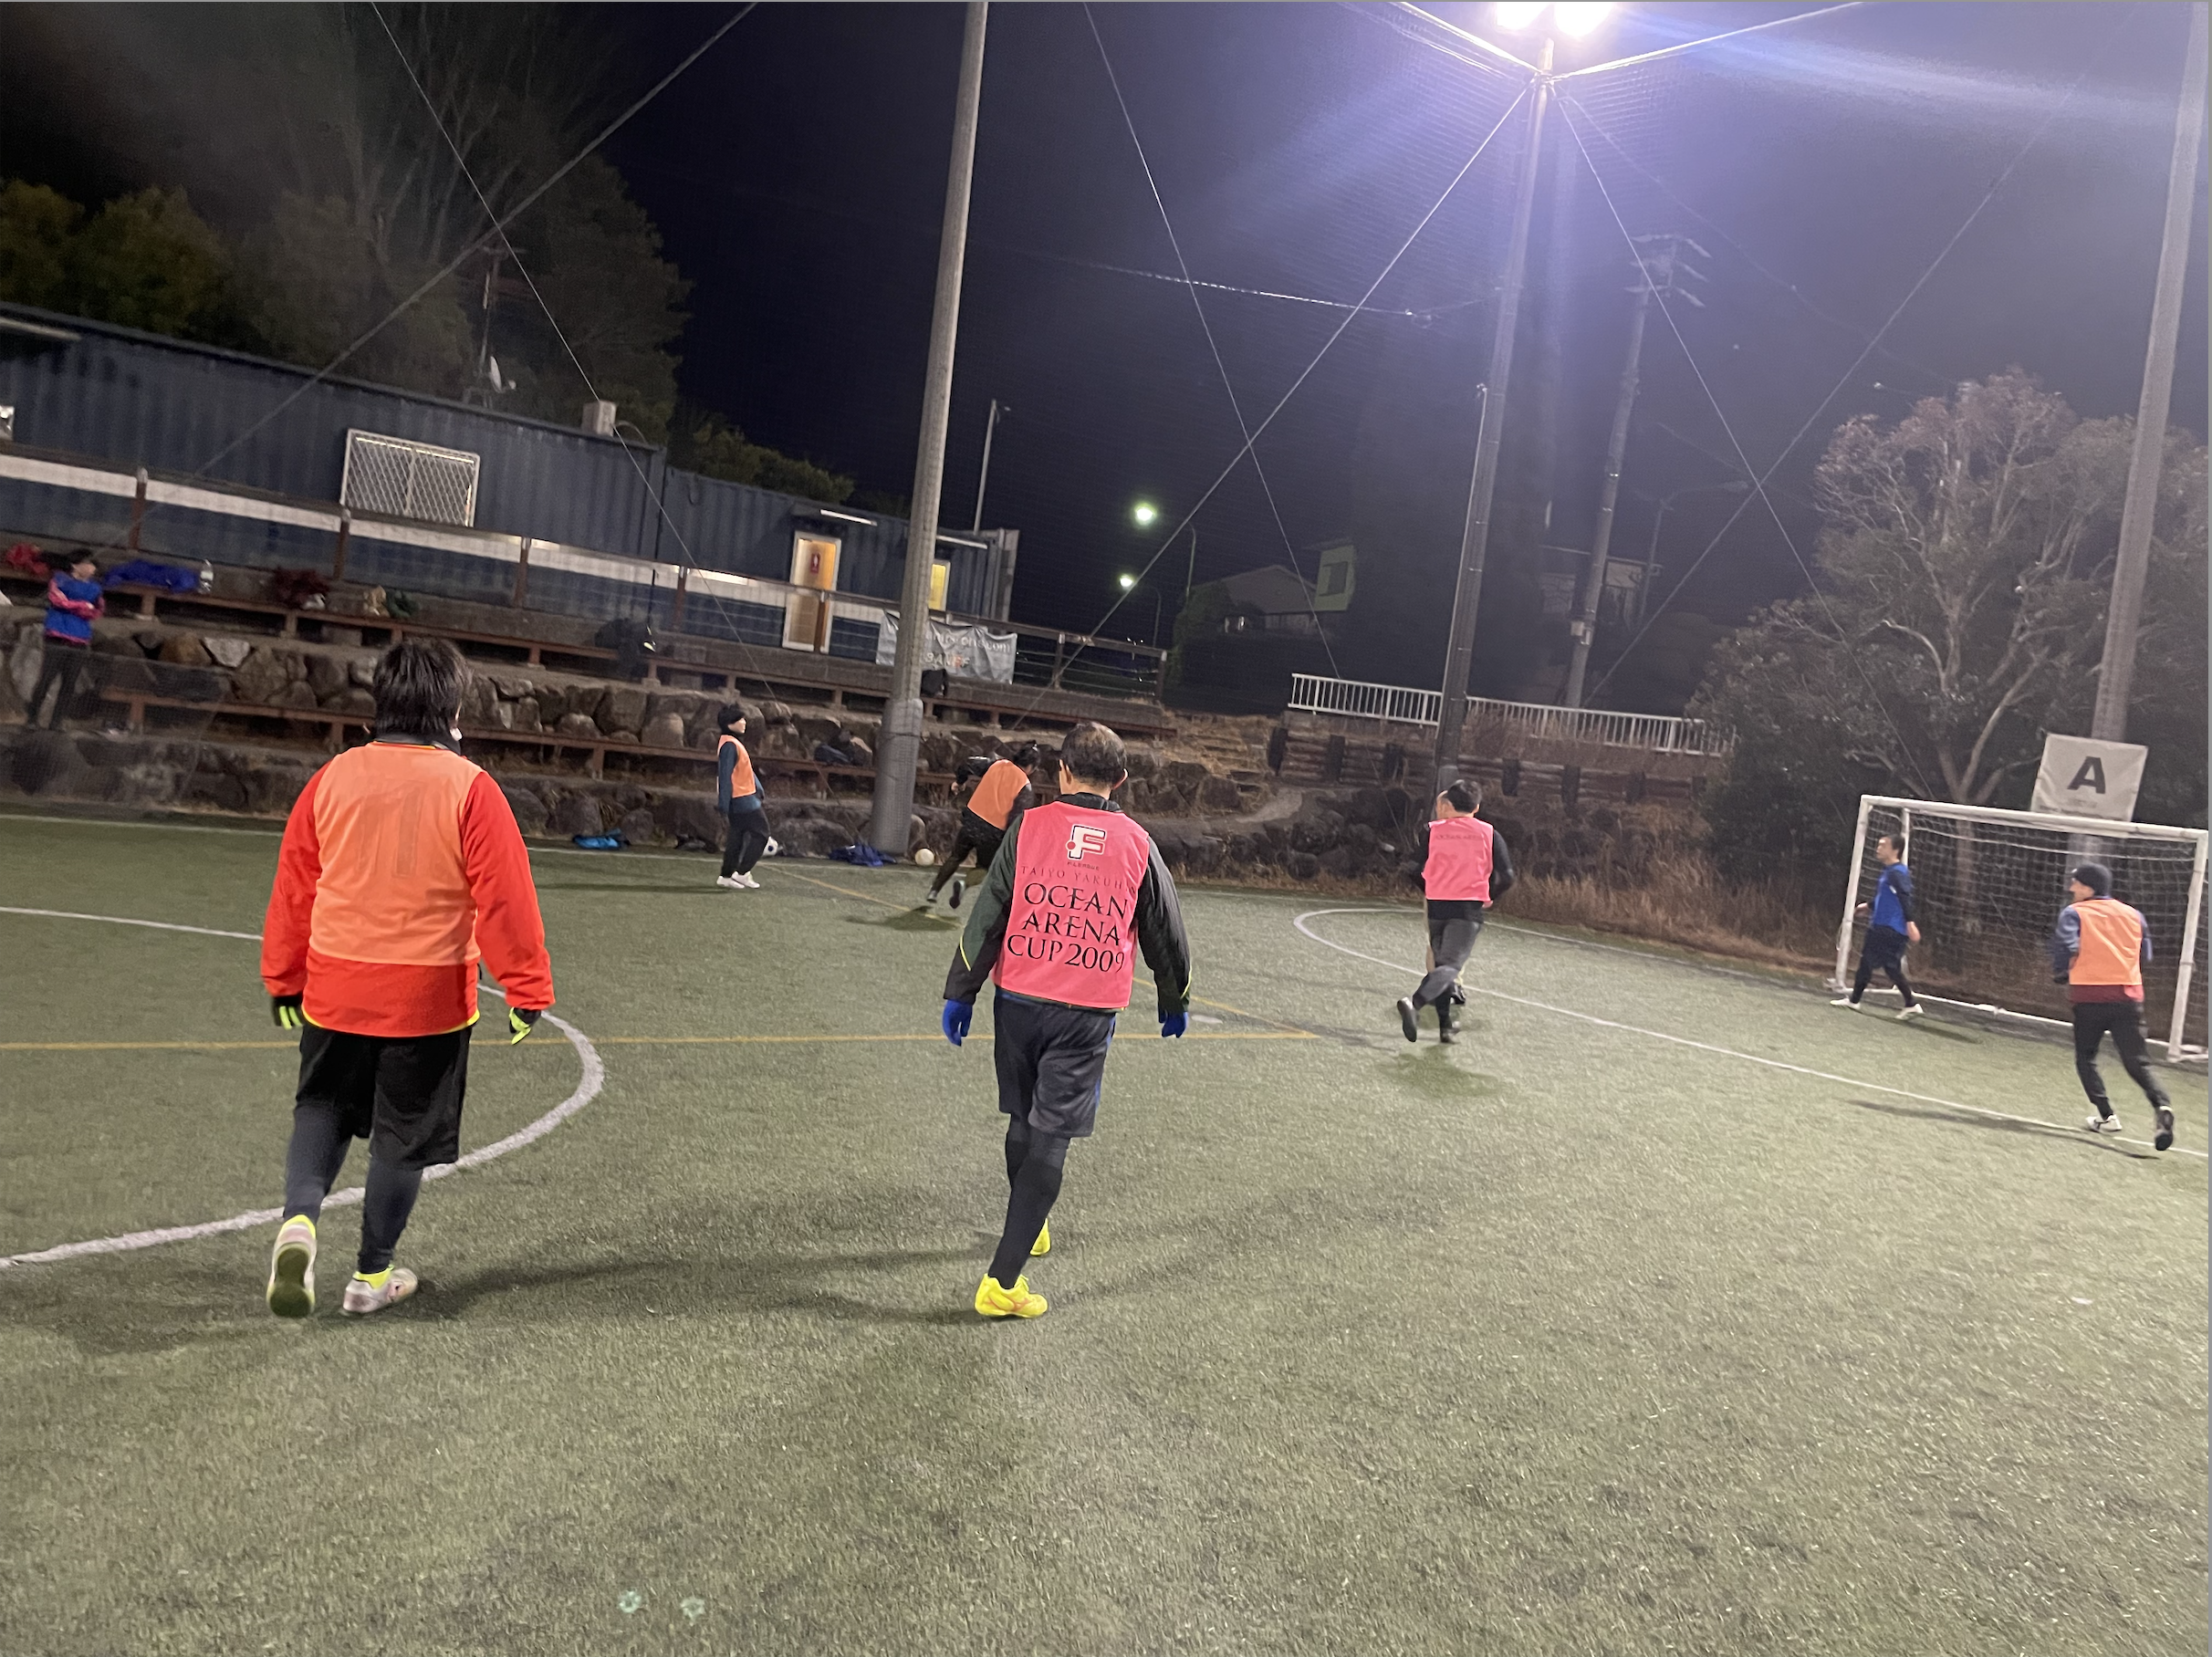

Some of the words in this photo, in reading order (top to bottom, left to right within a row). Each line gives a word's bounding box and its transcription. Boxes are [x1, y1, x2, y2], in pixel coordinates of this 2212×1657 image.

[2067, 756, 2106, 795] A
[1021, 866, 1065, 879] TAIYO
[1024, 882, 1129, 920] OCEAN
[1021, 910, 1121, 946] ARENA
[1007, 934, 1063, 963] CUP
[1064, 943, 1125, 974] 2009
